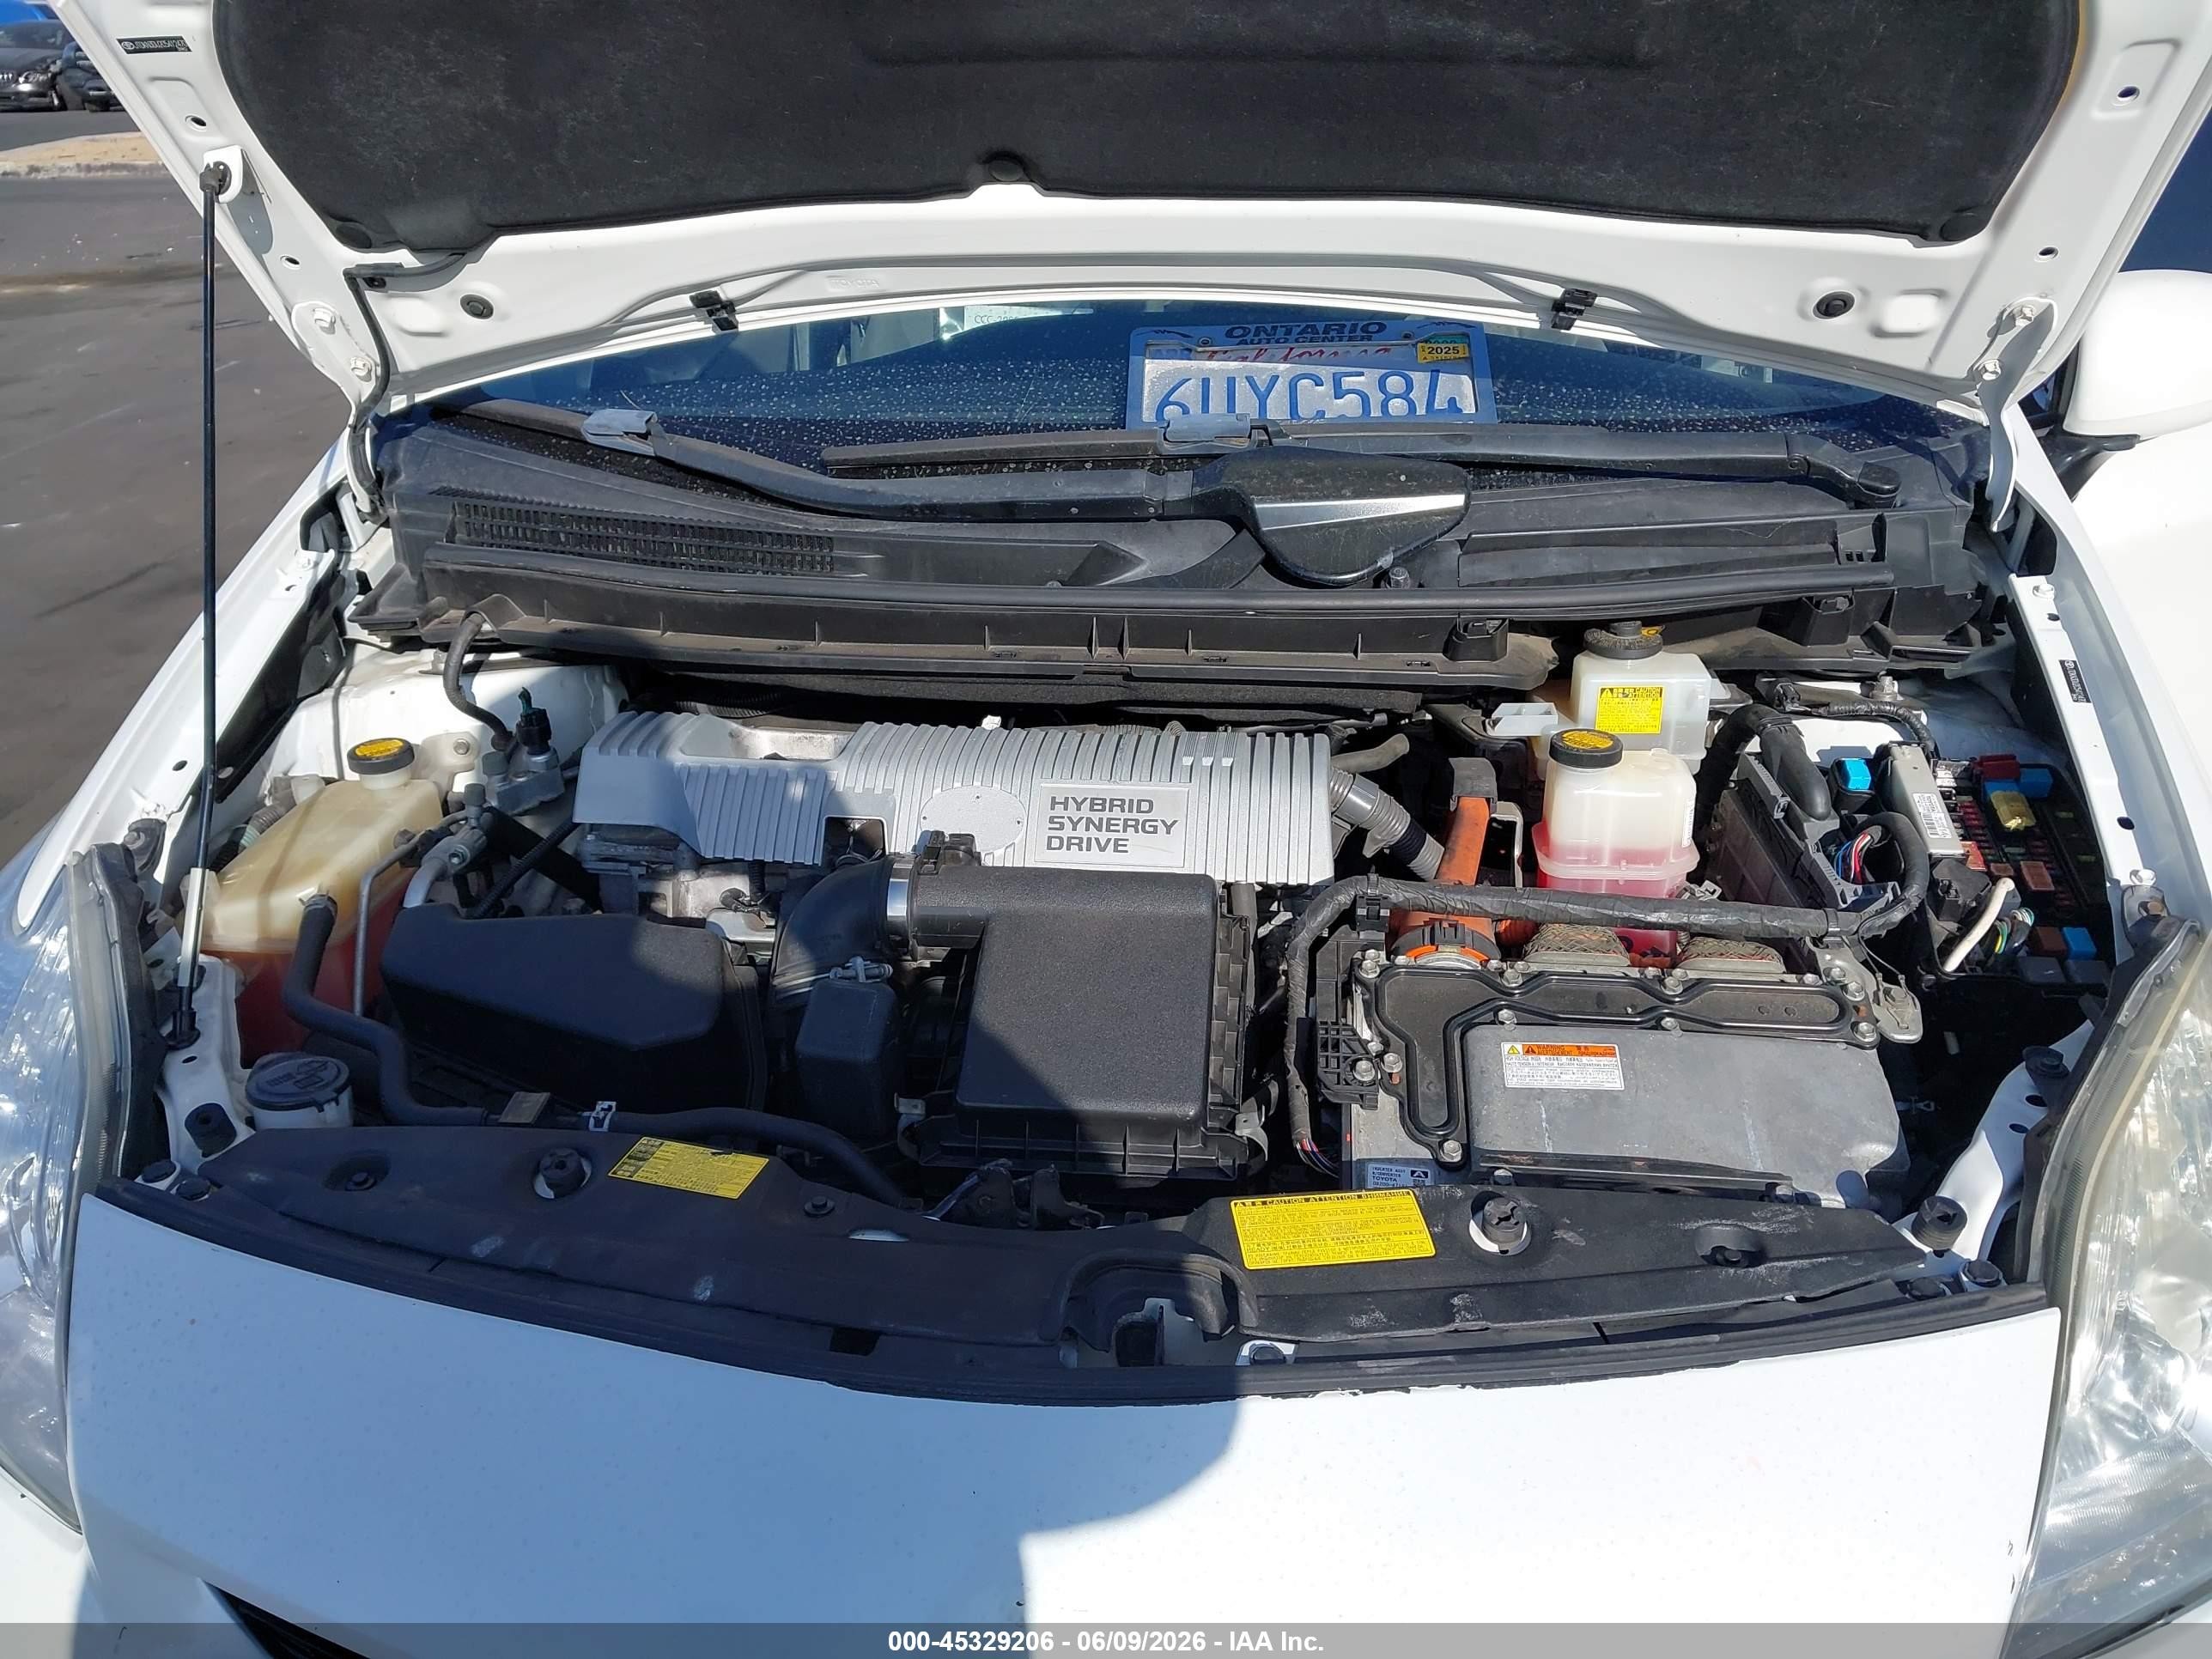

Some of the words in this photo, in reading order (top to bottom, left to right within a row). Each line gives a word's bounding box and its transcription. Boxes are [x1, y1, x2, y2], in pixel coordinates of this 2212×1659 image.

[830, 279, 880, 289] TOYOTA
[1224, 321, 1388, 339] ONTARIO
[1237, 337, 1289, 345] AUTO
[1294, 335, 1374, 344] CENTER
[1427, 346, 1460, 355] 2025
[1050, 796, 1154, 814] HYBRID
[1048, 816, 1179, 835] SYNERGY
[1046, 836, 1130, 854] DRIVE
[1267, 1197, 1305, 1206] CAUTION
[1309, 1194, 1358, 1203] ATTENTION
[1361, 1190, 1409, 1200] ВНИМАНИЕ
